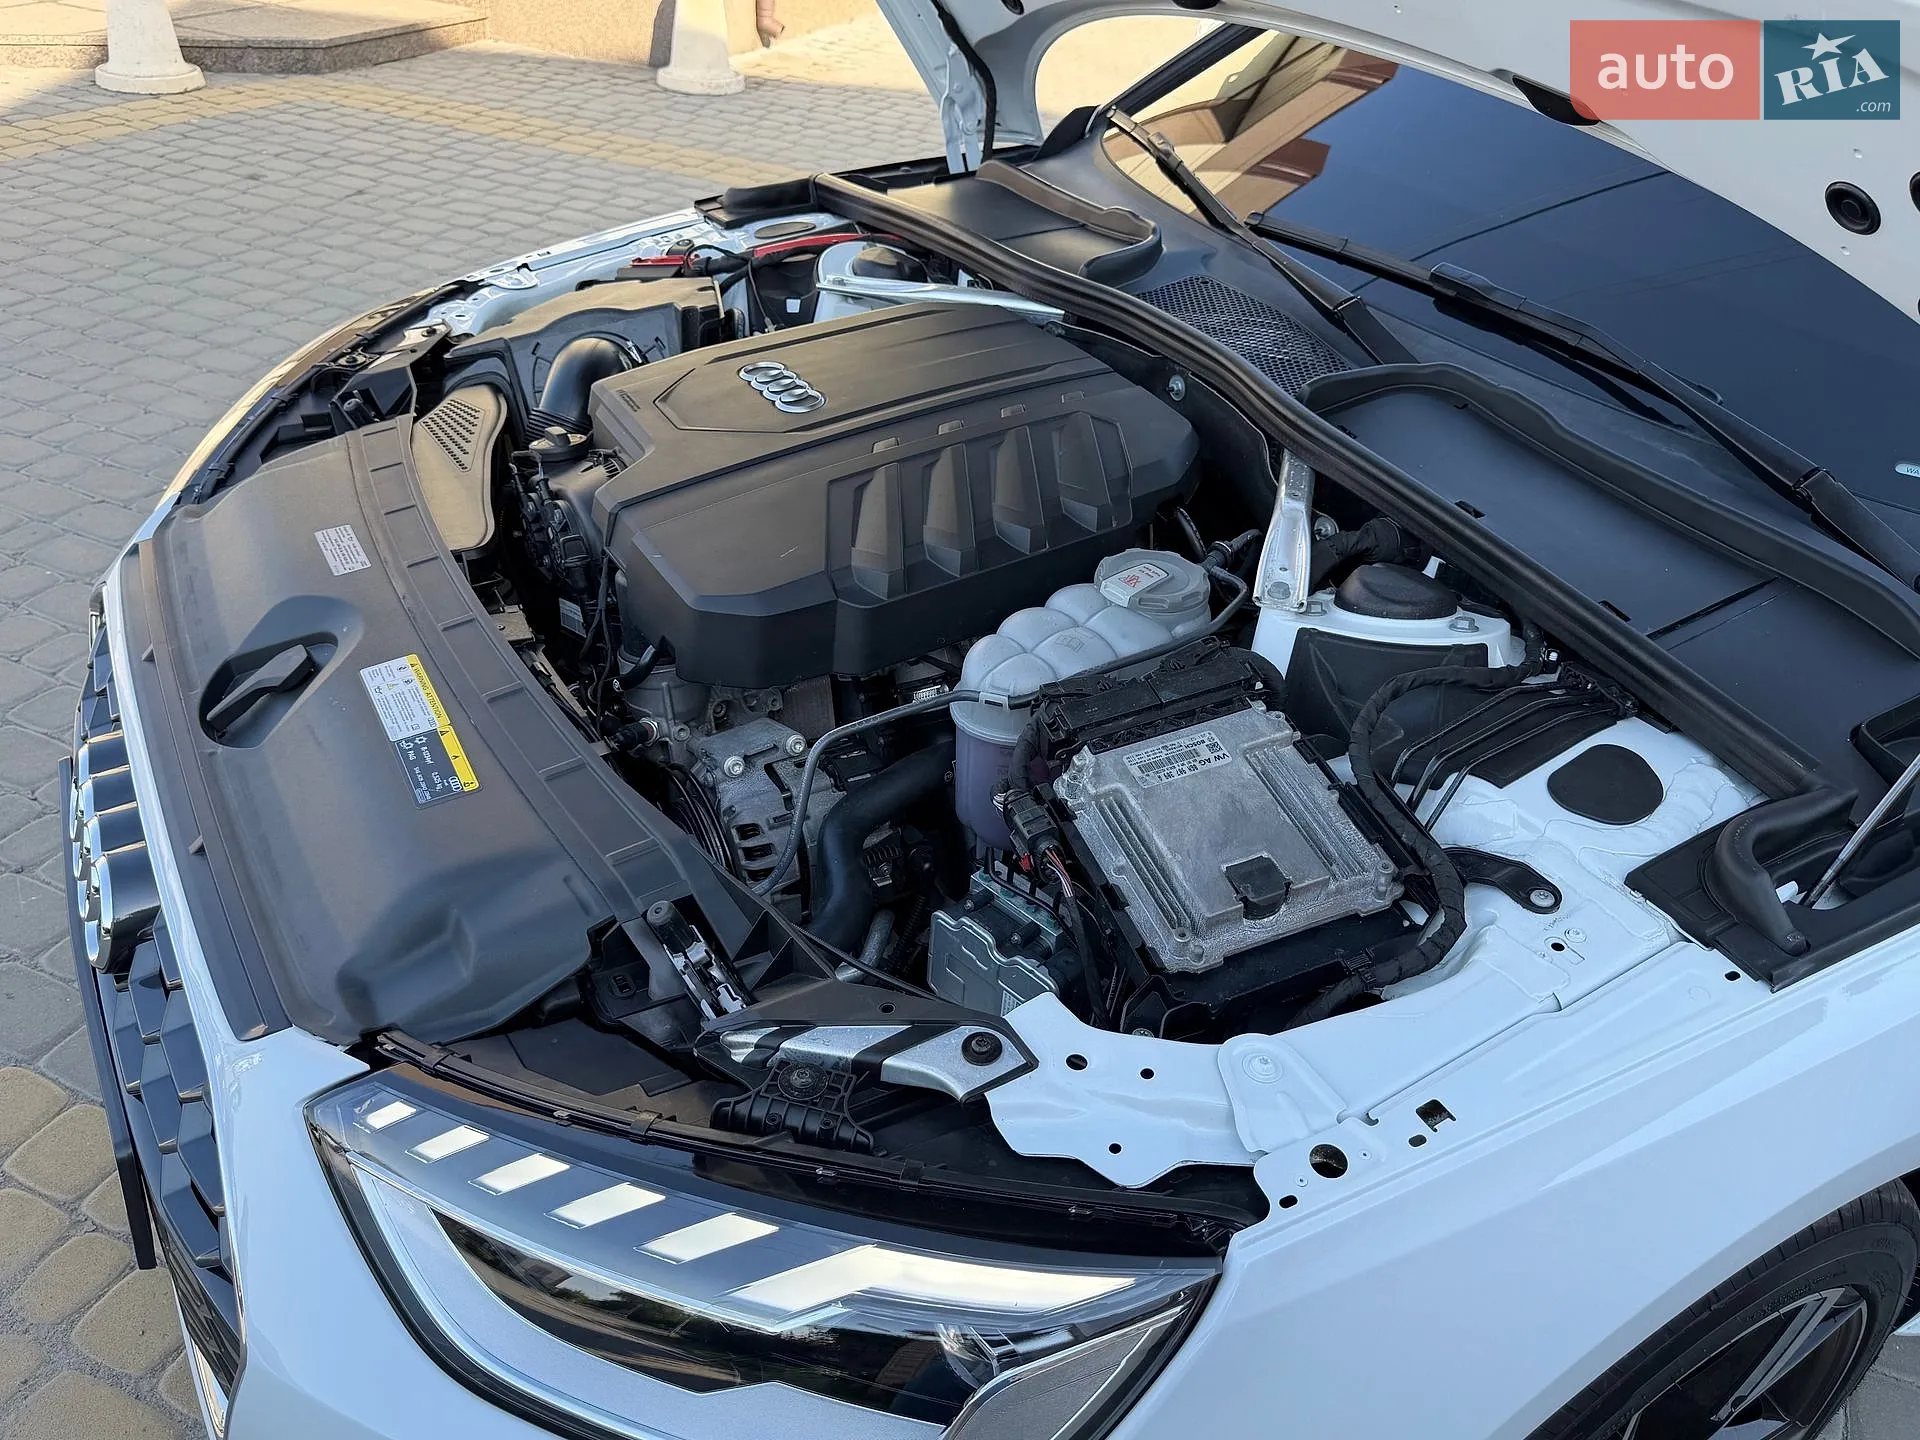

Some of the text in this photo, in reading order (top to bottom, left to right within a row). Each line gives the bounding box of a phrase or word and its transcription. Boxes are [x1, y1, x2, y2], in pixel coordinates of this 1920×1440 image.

[413, 668, 428, 690] WARNING
[425, 692, 442, 718] ATTENTION
[1183, 739, 1206, 749] BOSCH
[407, 750, 416, 760] PAG
[1197, 752, 1229, 766] VW AG
